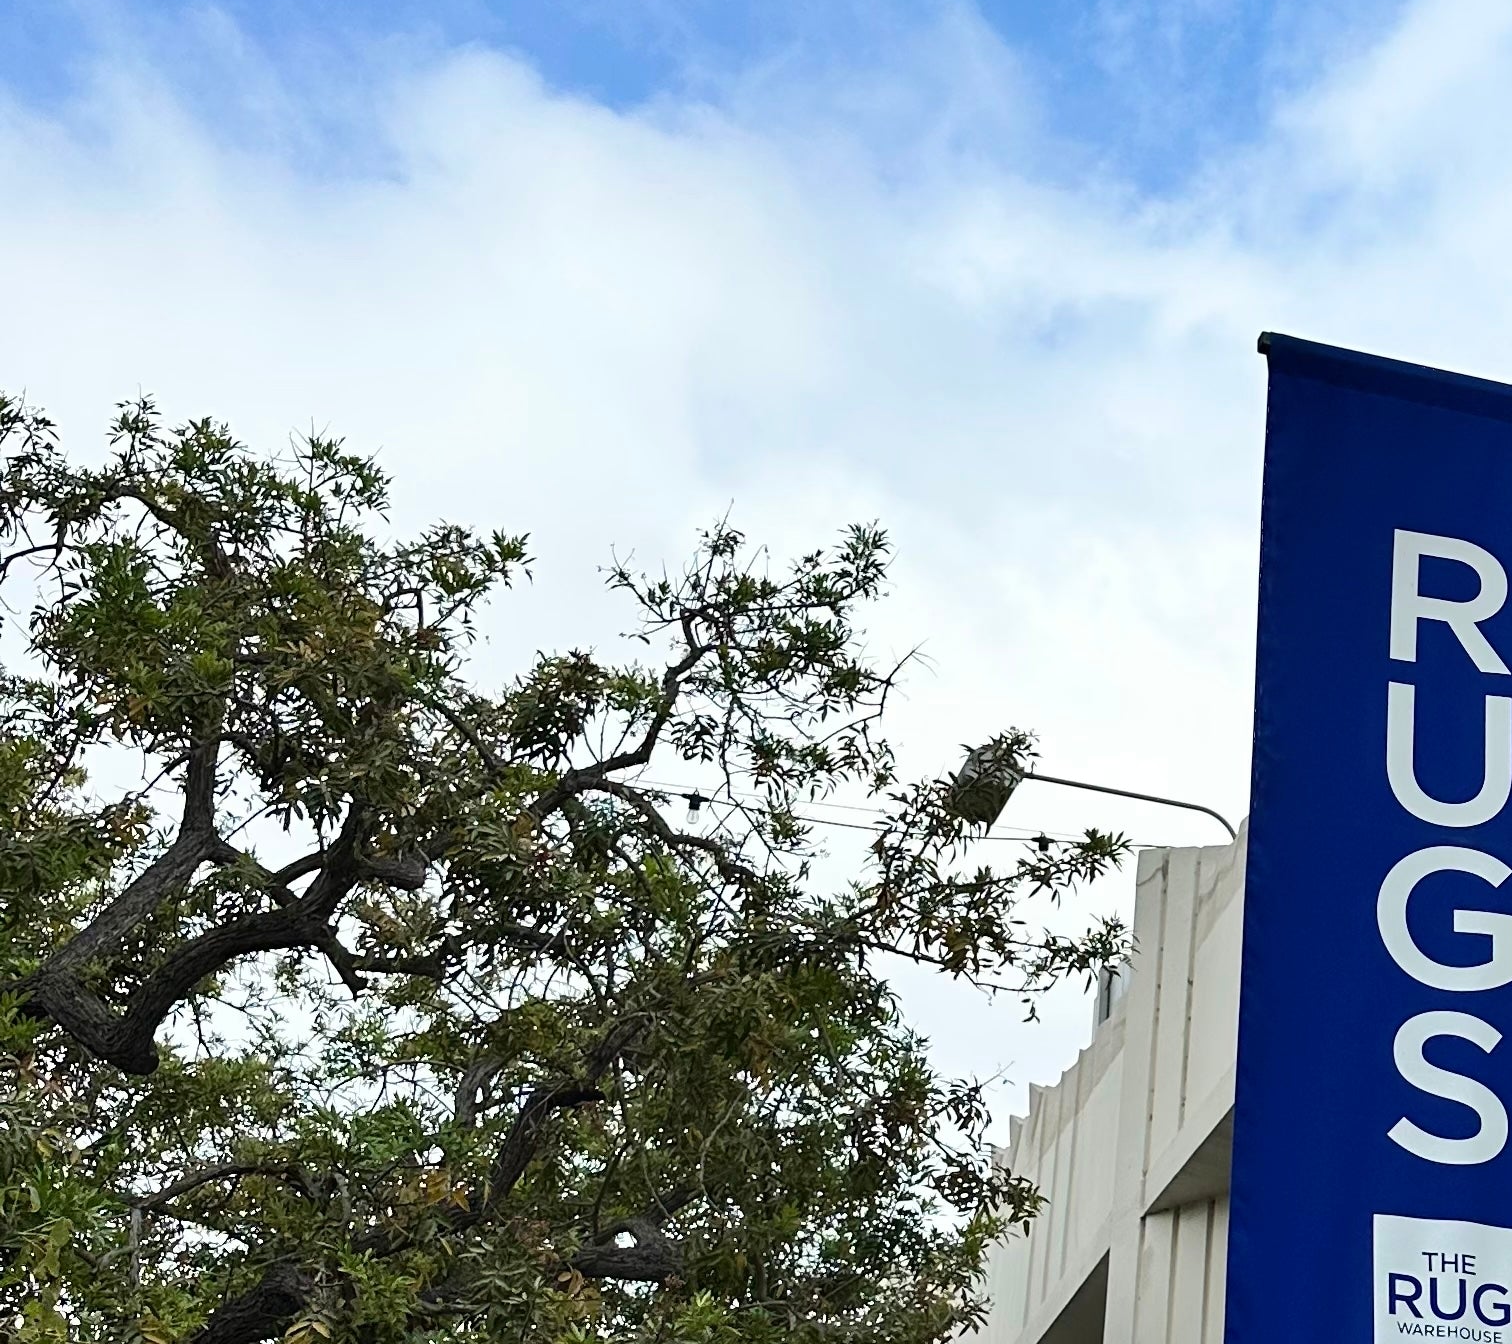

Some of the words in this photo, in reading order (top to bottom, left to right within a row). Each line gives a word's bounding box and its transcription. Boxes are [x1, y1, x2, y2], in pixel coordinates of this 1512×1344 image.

[1421, 1251, 1477, 1276] THE
[1388, 1272, 1512, 1327] RUG
[1397, 1321, 1504, 1344] WAREHOUSE
